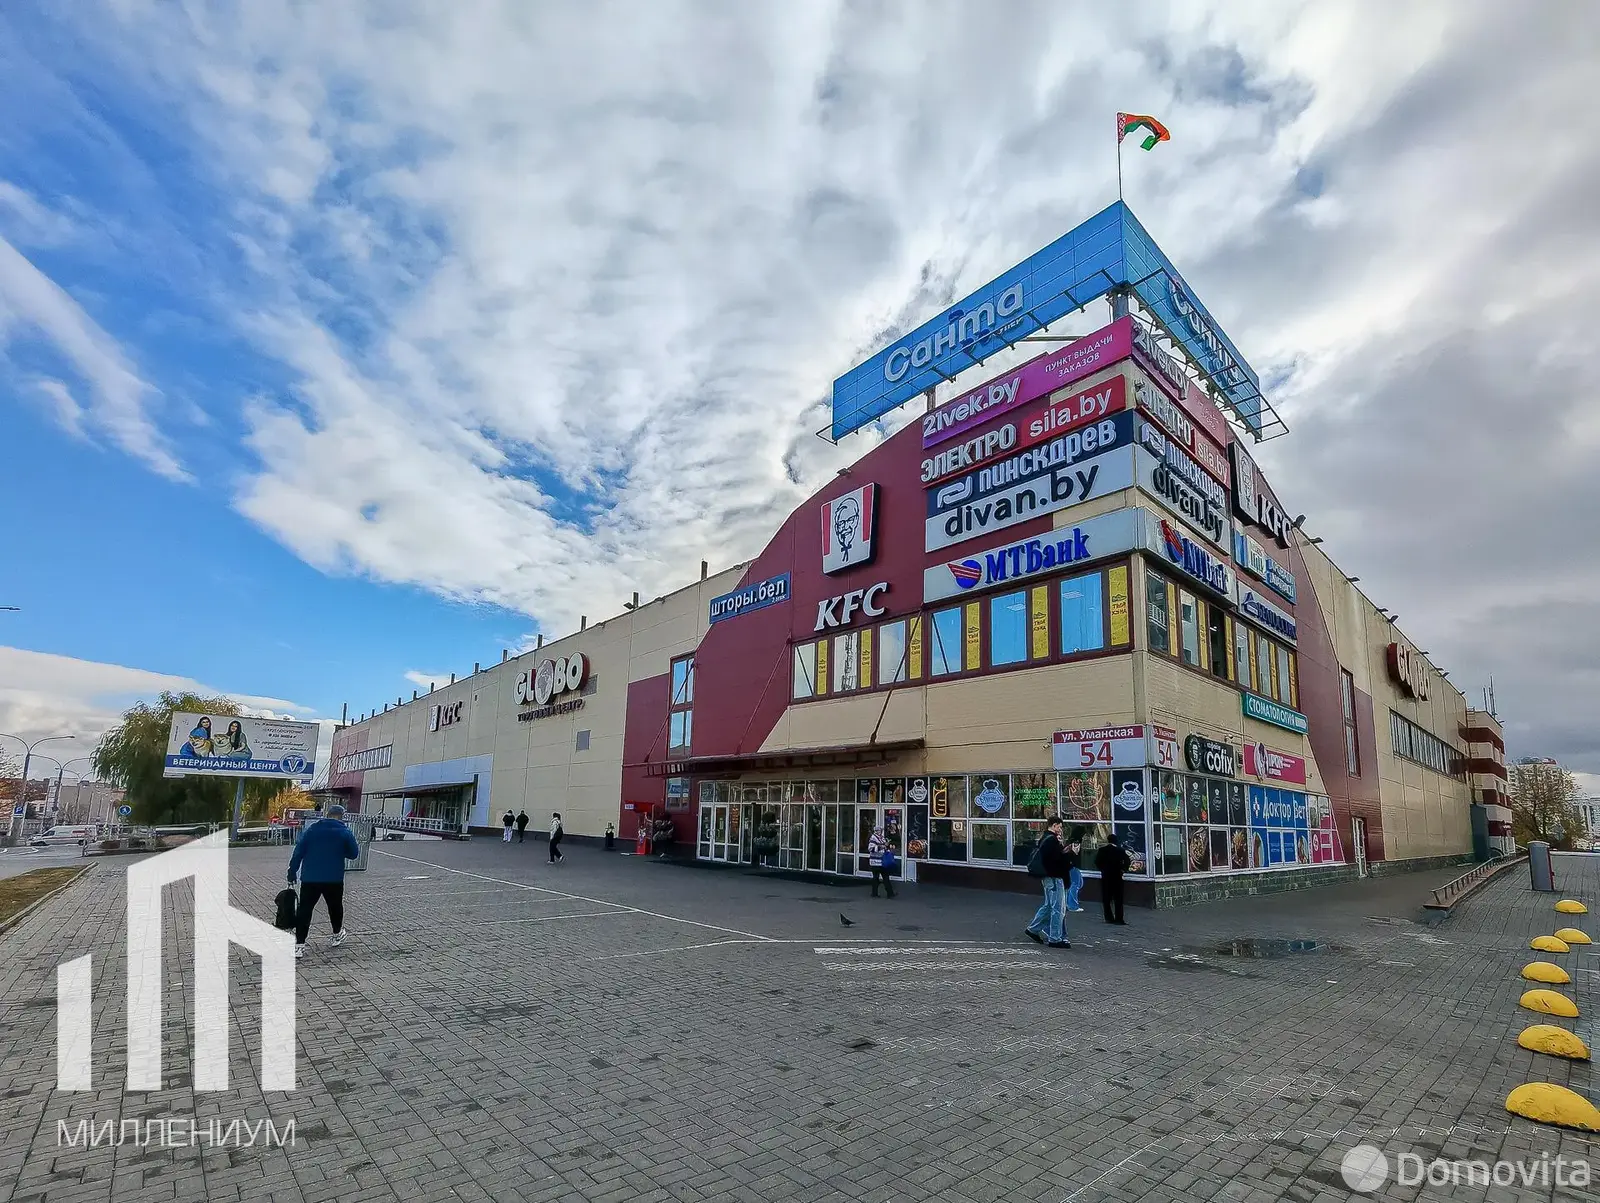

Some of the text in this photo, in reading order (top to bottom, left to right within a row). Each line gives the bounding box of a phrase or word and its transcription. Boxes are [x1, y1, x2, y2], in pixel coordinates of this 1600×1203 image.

[884, 283, 1024, 382] Санта
[1045, 334, 1113, 373] ПУНКТ ВЫДАЧИ
[1058, 352, 1100, 378] ЗАКАЗОВ
[923, 377, 1021, 438] 21vek.by
[1029, 388, 1112, 437] sila.by
[920, 423, 1017, 483] ЭЛЕКТРО
[1198, 442, 1227, 484] sila.by
[945, 464, 1100, 536] divan.by
[1153, 462, 1223, 542] divan.by
[1259, 494, 1292, 548] KFC
[985, 528, 1092, 584] МТБанк
[711, 579, 785, 616] шторы.бел
[814, 582, 888, 632] KFC
[513, 652, 586, 705] GLOBO
[1061, 727, 1134, 743] ул. Уманская
[1080, 742, 1114, 767] 54
[1158, 740, 1173, 767] 54
[172, 758, 278, 771] ВЕТЕРИНАРНЫЙ ЦЕНТР
[1206, 748, 1234, 775] cofix
[1262, 797, 1292, 822] Доктор
[1293, 800, 1306, 819] Вет
